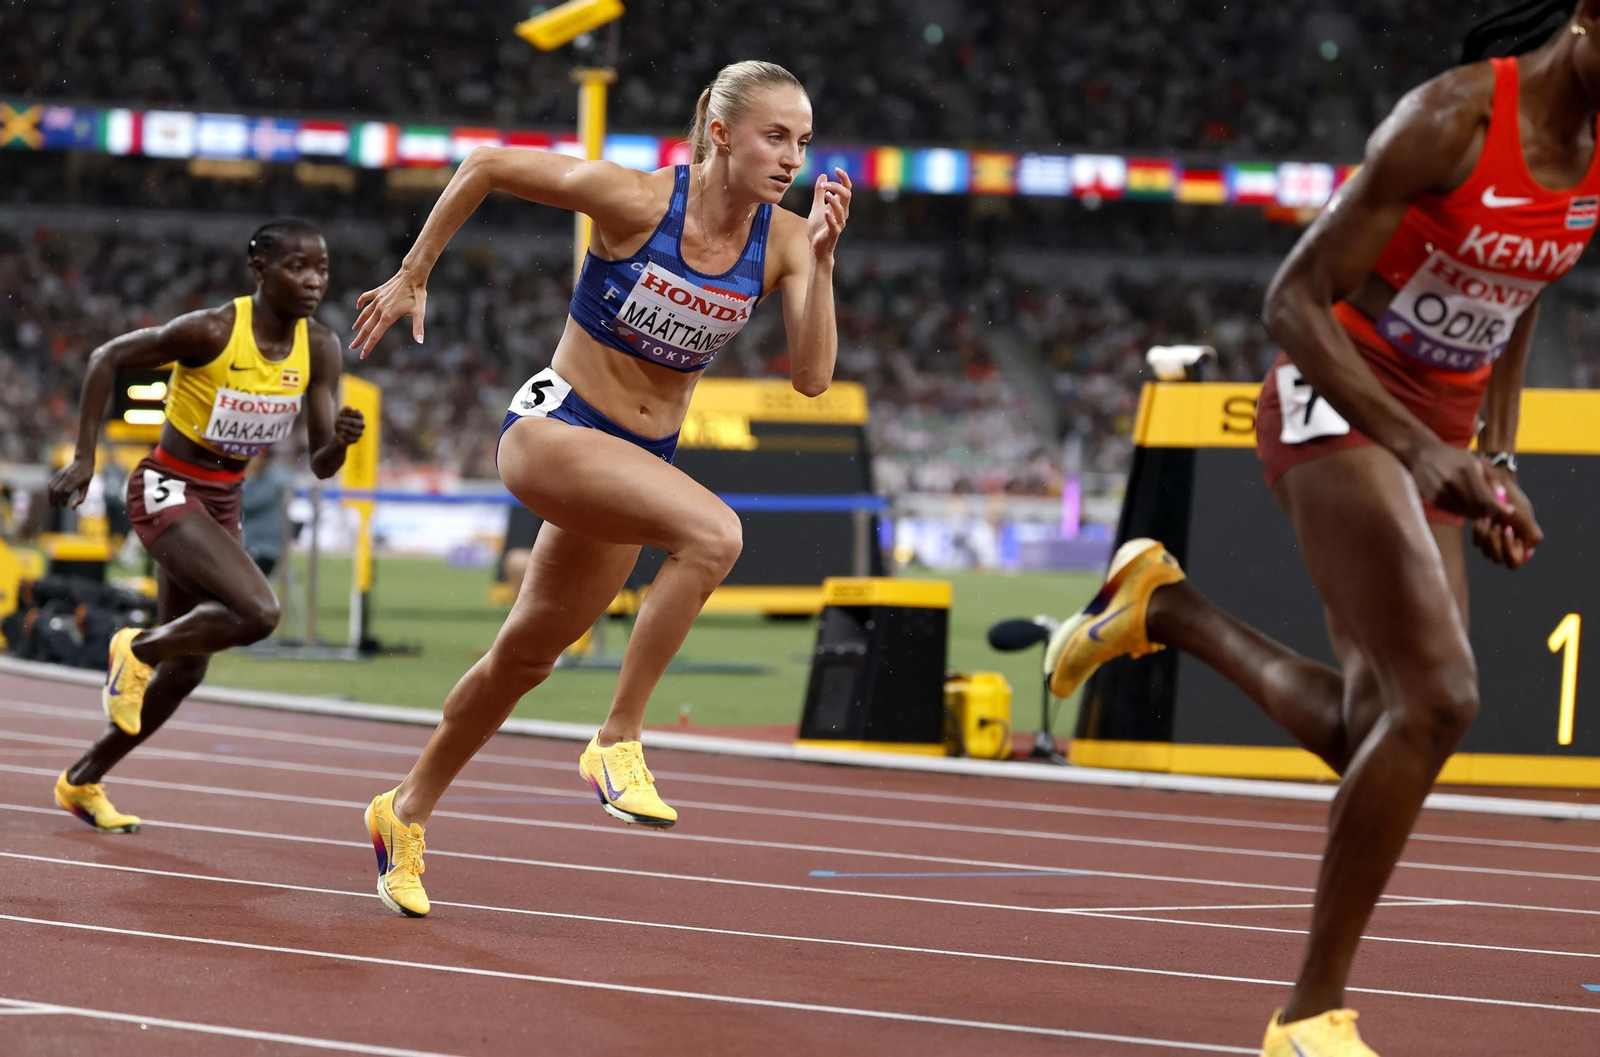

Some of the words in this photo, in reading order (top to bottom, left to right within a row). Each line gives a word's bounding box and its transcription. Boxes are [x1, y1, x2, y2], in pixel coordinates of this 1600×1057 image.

[640, 271, 748, 322] HONDA
[218, 394, 298, 415] HONDA
[520, 379, 555, 410] 5
[153, 477, 171, 504] 5
[1547, 612, 1582, 746] 1
